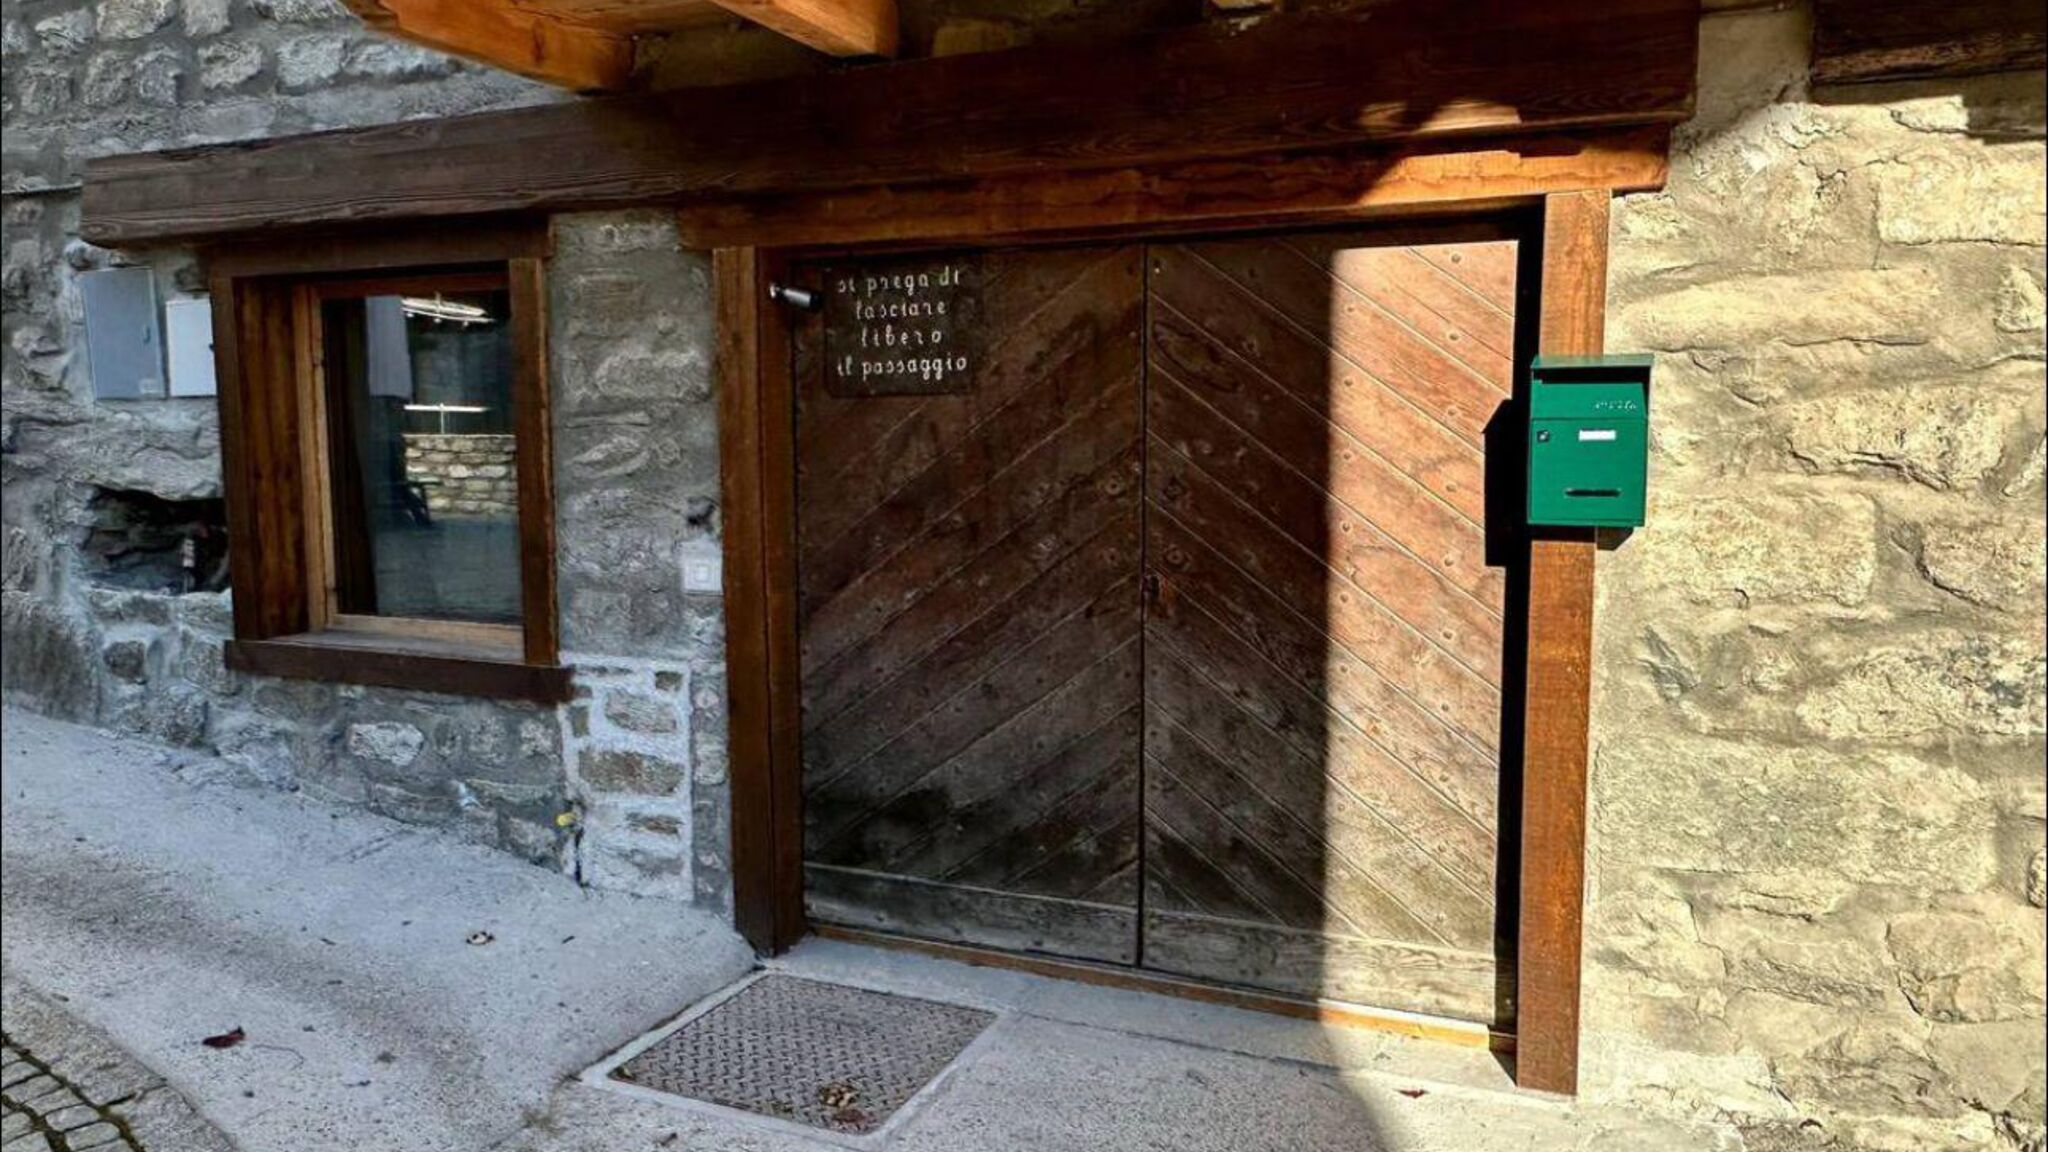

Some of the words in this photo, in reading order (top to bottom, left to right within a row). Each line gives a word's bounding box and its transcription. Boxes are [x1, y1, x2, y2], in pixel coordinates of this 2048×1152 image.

[837, 277, 857, 294] si
[866, 273, 931, 297] prega
[938, 265, 960, 287] di
[856, 300, 947, 321] lasciare
[861, 324, 943, 347] libero
[837, 355, 853, 377] il
[862, 353, 968, 382] passaggio
